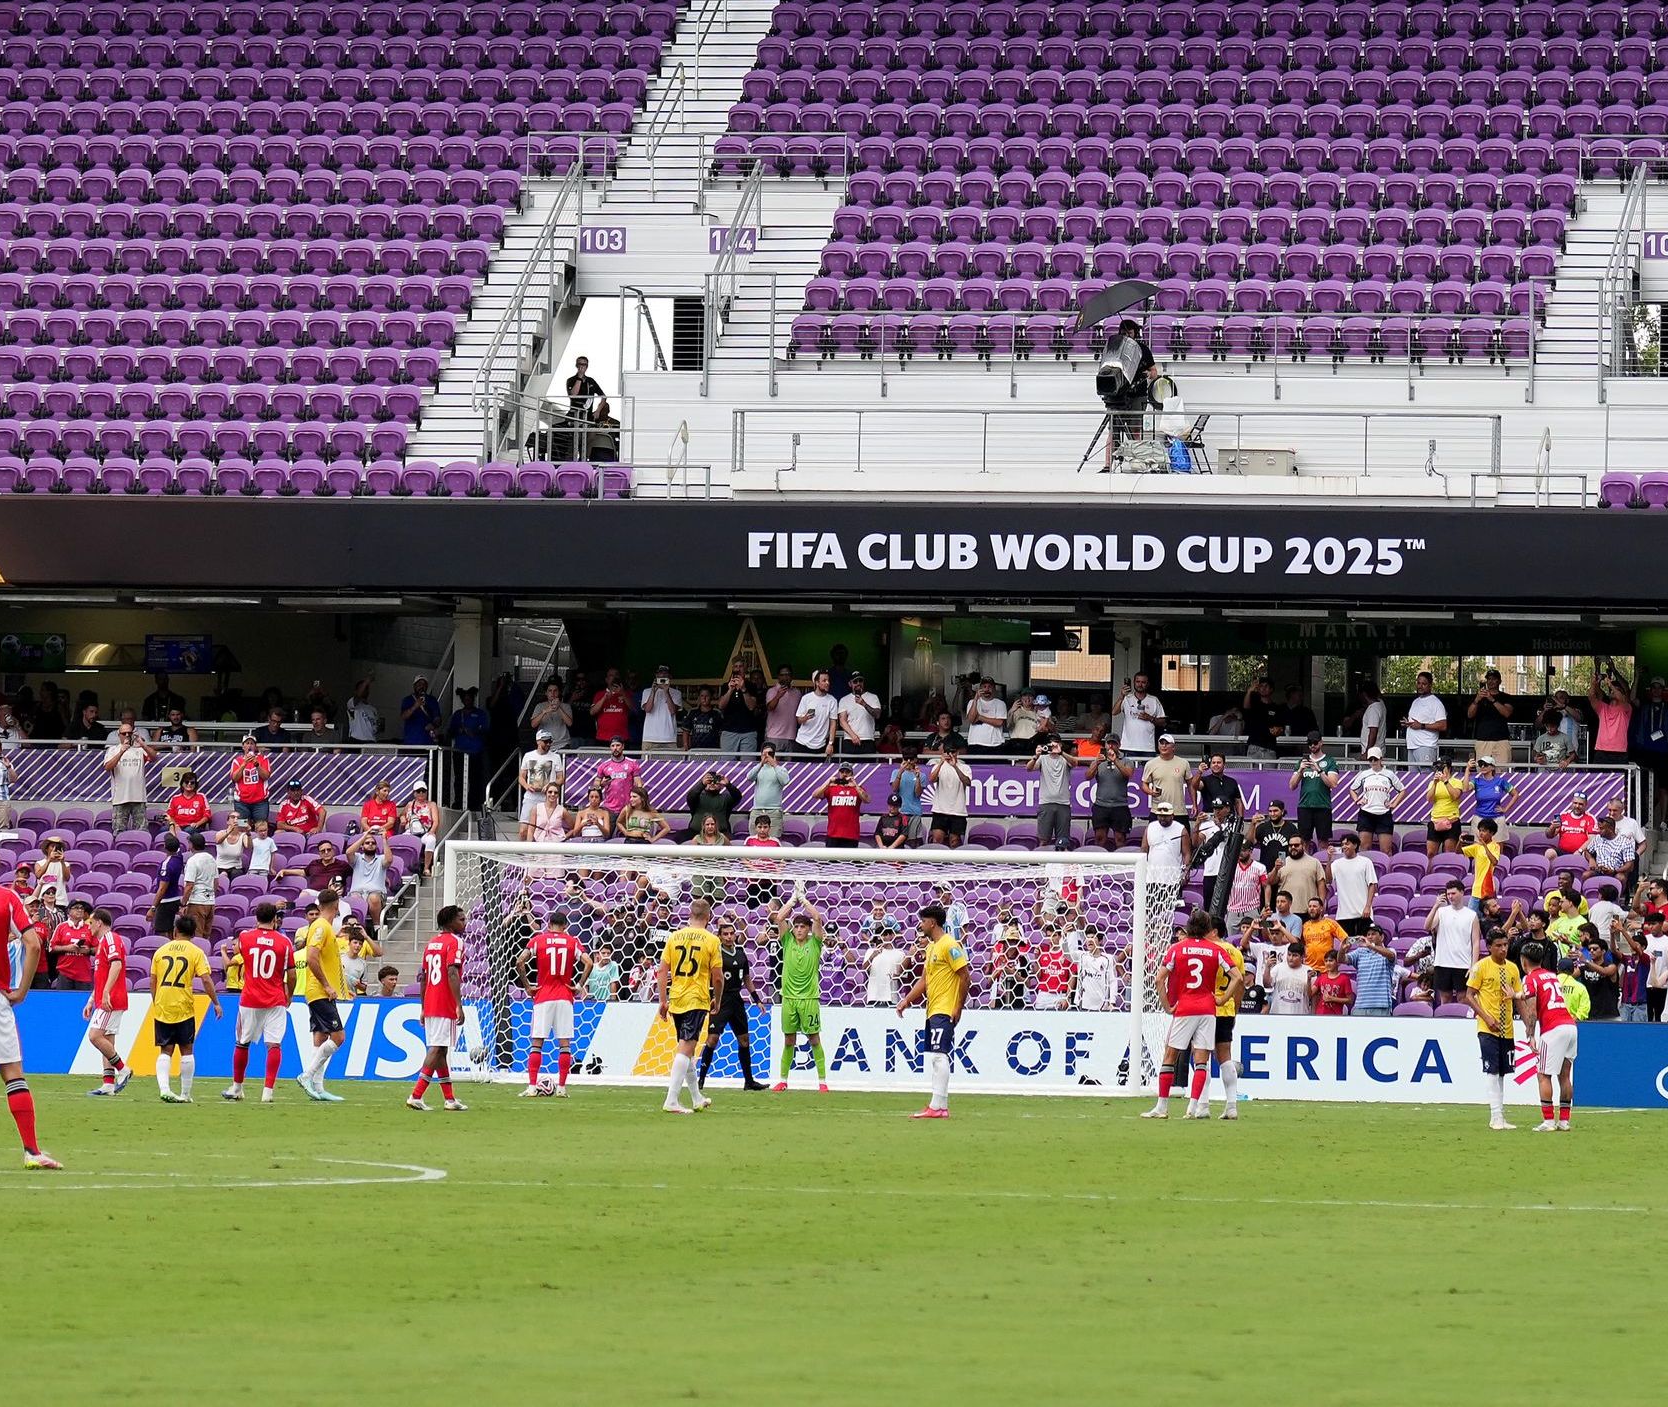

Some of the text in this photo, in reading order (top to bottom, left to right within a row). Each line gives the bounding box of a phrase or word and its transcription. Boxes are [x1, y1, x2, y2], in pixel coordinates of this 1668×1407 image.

[582, 229, 623, 250] 103
[747, 531, 847, 569] FIFA
[858, 533, 979, 571] CLUB
[991, 534, 1167, 572] WORLD
[1177, 535, 1273, 574] CUP
[173, 772, 180, 781] 3
[161, 955, 188, 988] 22
[249, 947, 276, 979] 10
[426, 954, 442, 986] 18
[546, 947, 568, 975] 11
[675, 945, 701, 977] 25
[1186, 958, 1204, 989] 3
[808, 1014, 819, 1027] 24
[930, 1028, 944, 1045] 27
[1007, 1031, 1096, 1077] OF
